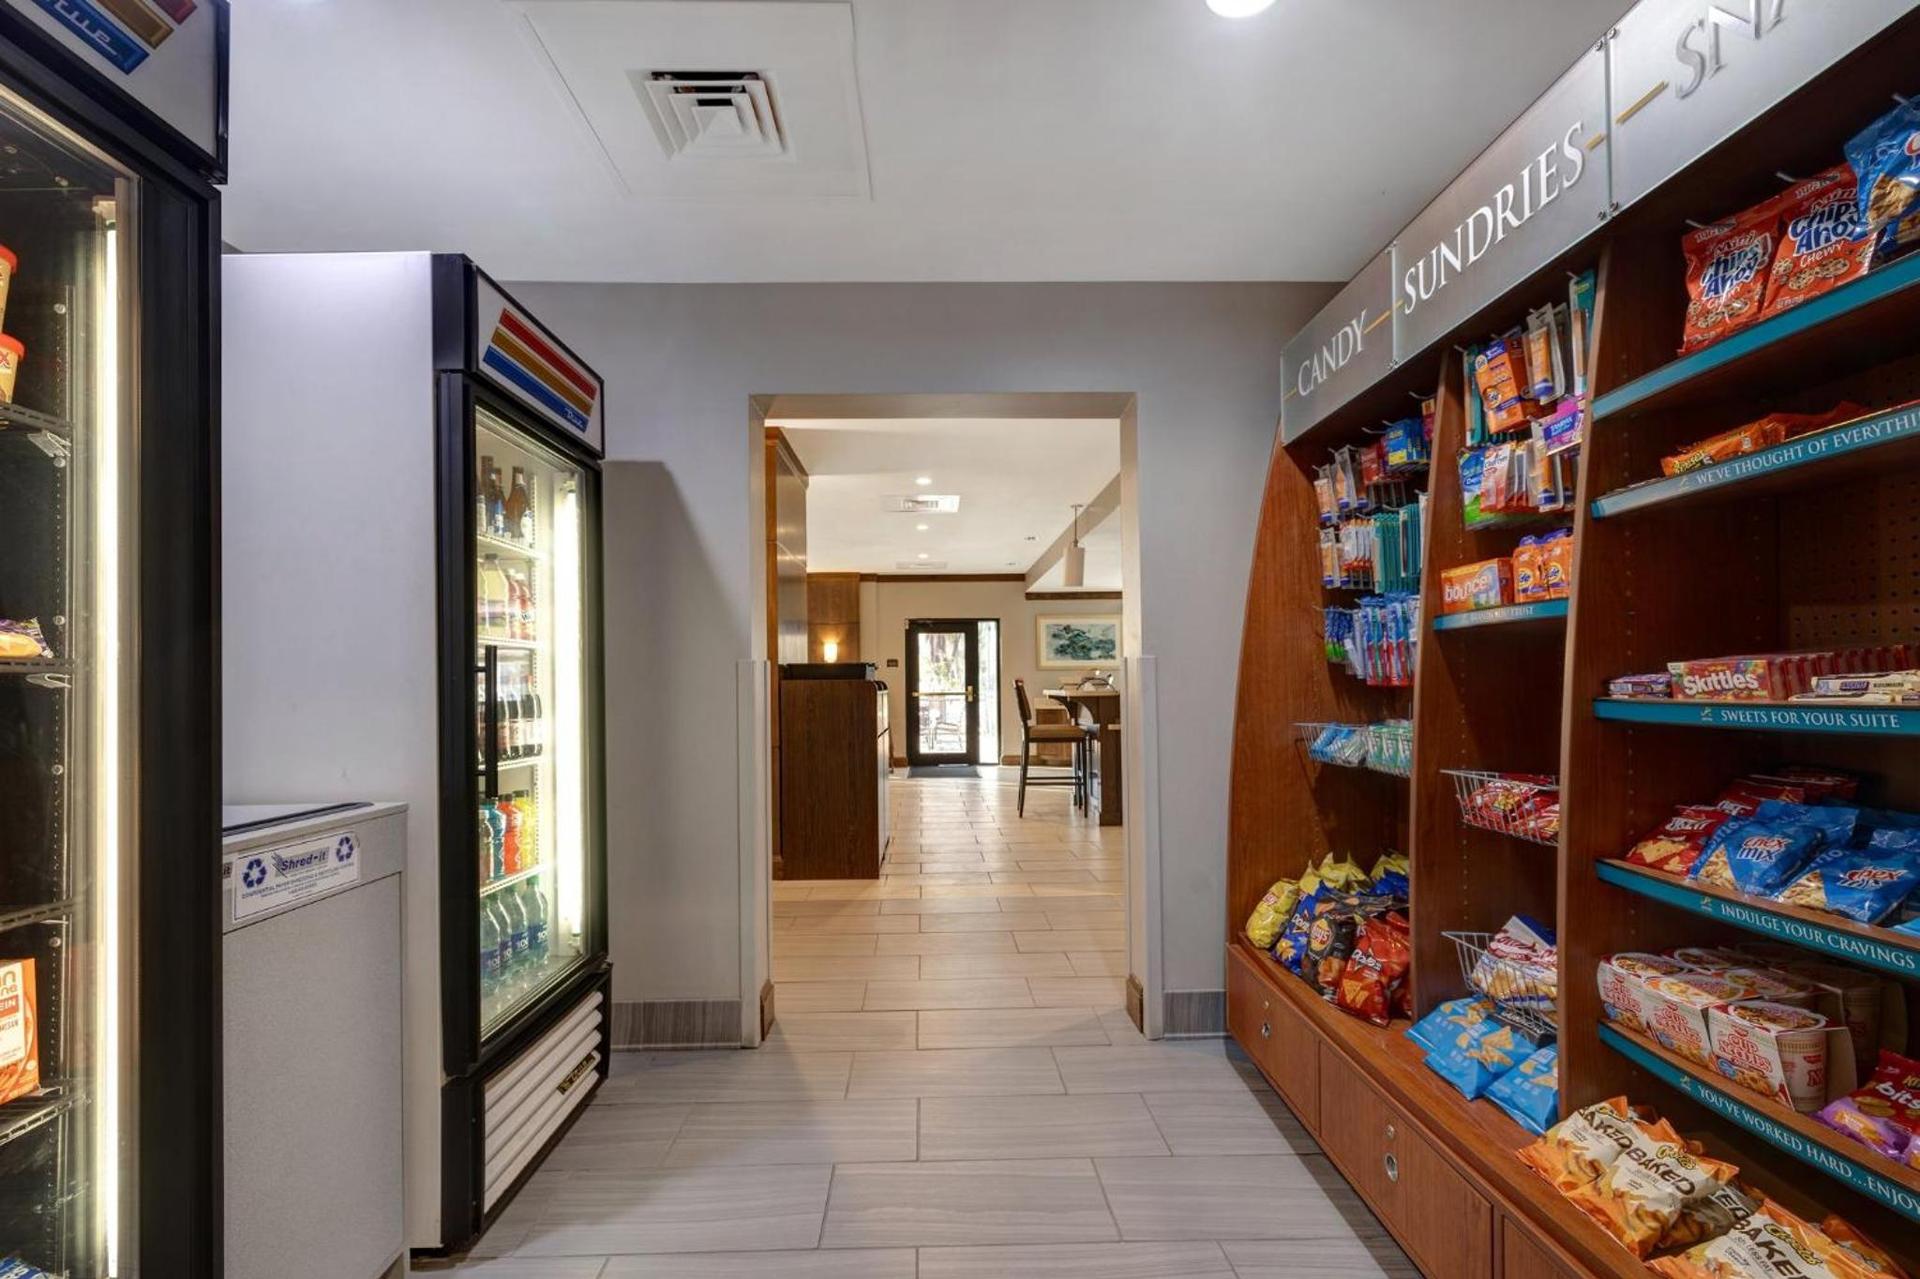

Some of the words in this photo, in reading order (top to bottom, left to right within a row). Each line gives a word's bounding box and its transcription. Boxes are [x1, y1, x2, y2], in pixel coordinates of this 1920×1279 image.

[1404, 121, 1584, 315] SUNDRIES
[1297, 308, 1368, 397] CANDY
[1733, 446, 1804, 475] THOUGHT
[1807, 440, 1828, 456] OF
[1834, 411, 1920, 448] EVERYTHI
[1684, 671, 1760, 696] Skittles
[1721, 709, 1768, 724] SWEETS
[1771, 710, 1800, 726] FOR
[1801, 711, 1847, 727] YOUR
[1850, 713, 1900, 729] SUITE
[1721, 903, 1781, 932] INDULGE
[1783, 921, 1825, 945] YOUR
[1827, 934, 1916, 970] CRAVINGS
[1699, 1084, 1743, 1118] YOU'VE
[1743, 1110, 1802, 1151] WORKED
[1625, 1147, 1697, 1196] BAKED
[1732, 1217, 1814, 1279] BAKE
